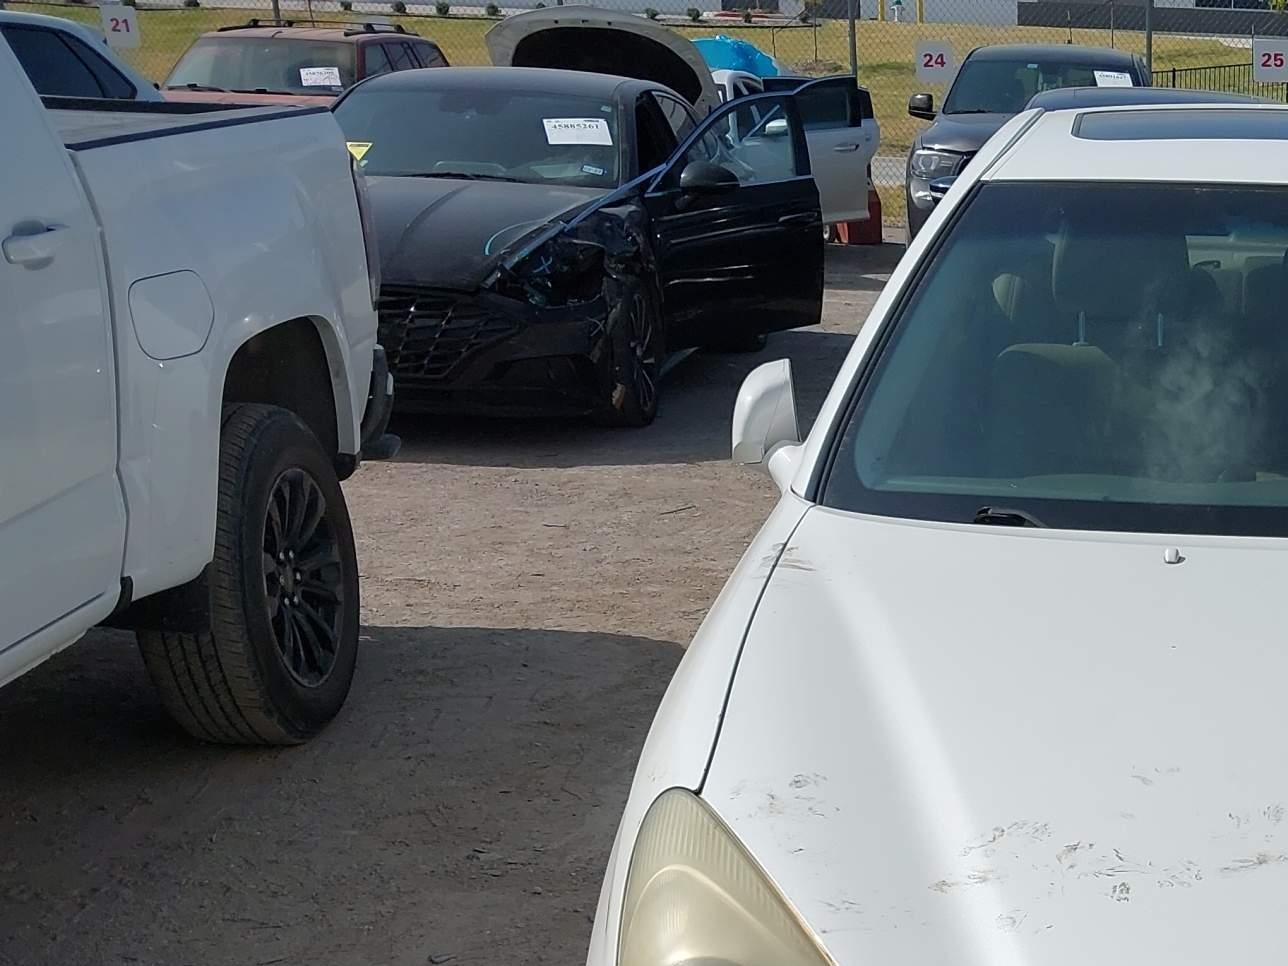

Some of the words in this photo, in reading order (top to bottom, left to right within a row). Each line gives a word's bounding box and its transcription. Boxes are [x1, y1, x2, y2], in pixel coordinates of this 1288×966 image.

[110, 18, 130, 32] 21
[923, 53, 946, 68] 24
[1261, 53, 1284, 68] 25
